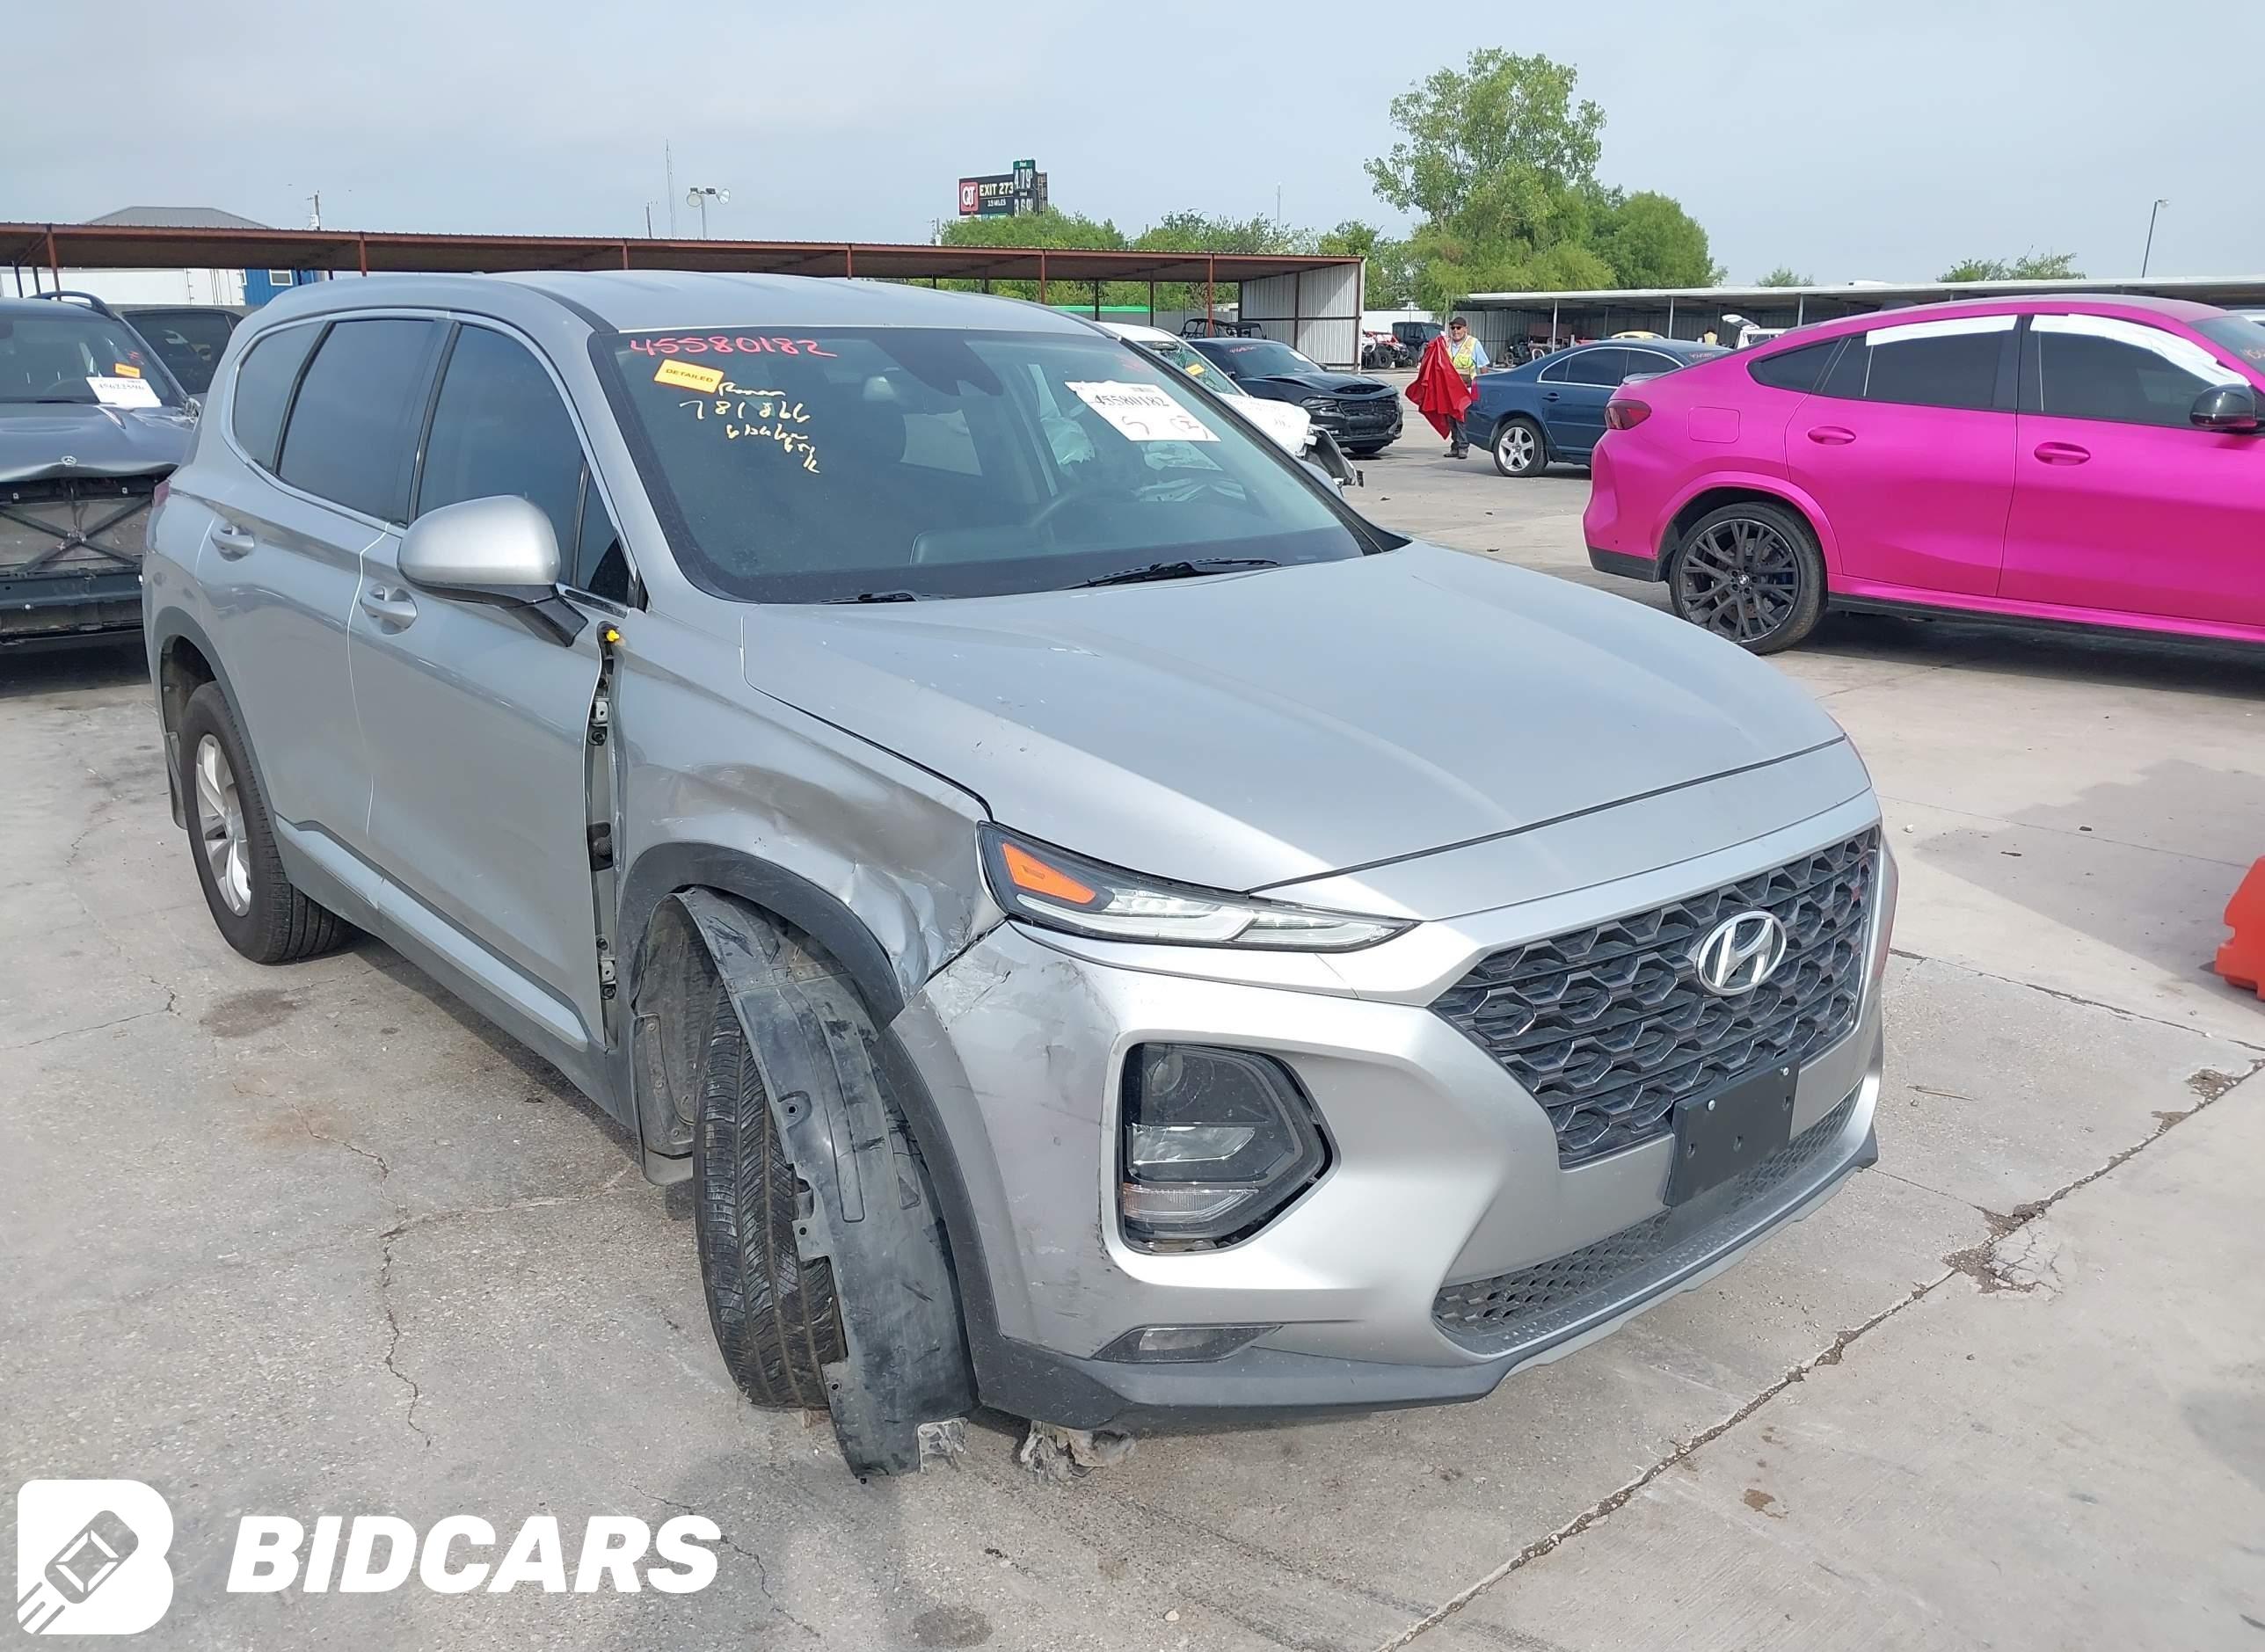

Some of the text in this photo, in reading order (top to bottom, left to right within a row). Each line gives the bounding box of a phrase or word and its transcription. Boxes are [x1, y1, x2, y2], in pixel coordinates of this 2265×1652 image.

[980, 181, 1013, 196] EXIT 273
[963, 186, 975, 207] QT
[630, 336, 838, 357] 45580182
[665, 368, 714, 382] DETAILED
[1094, 394, 1170, 407] 45580182
